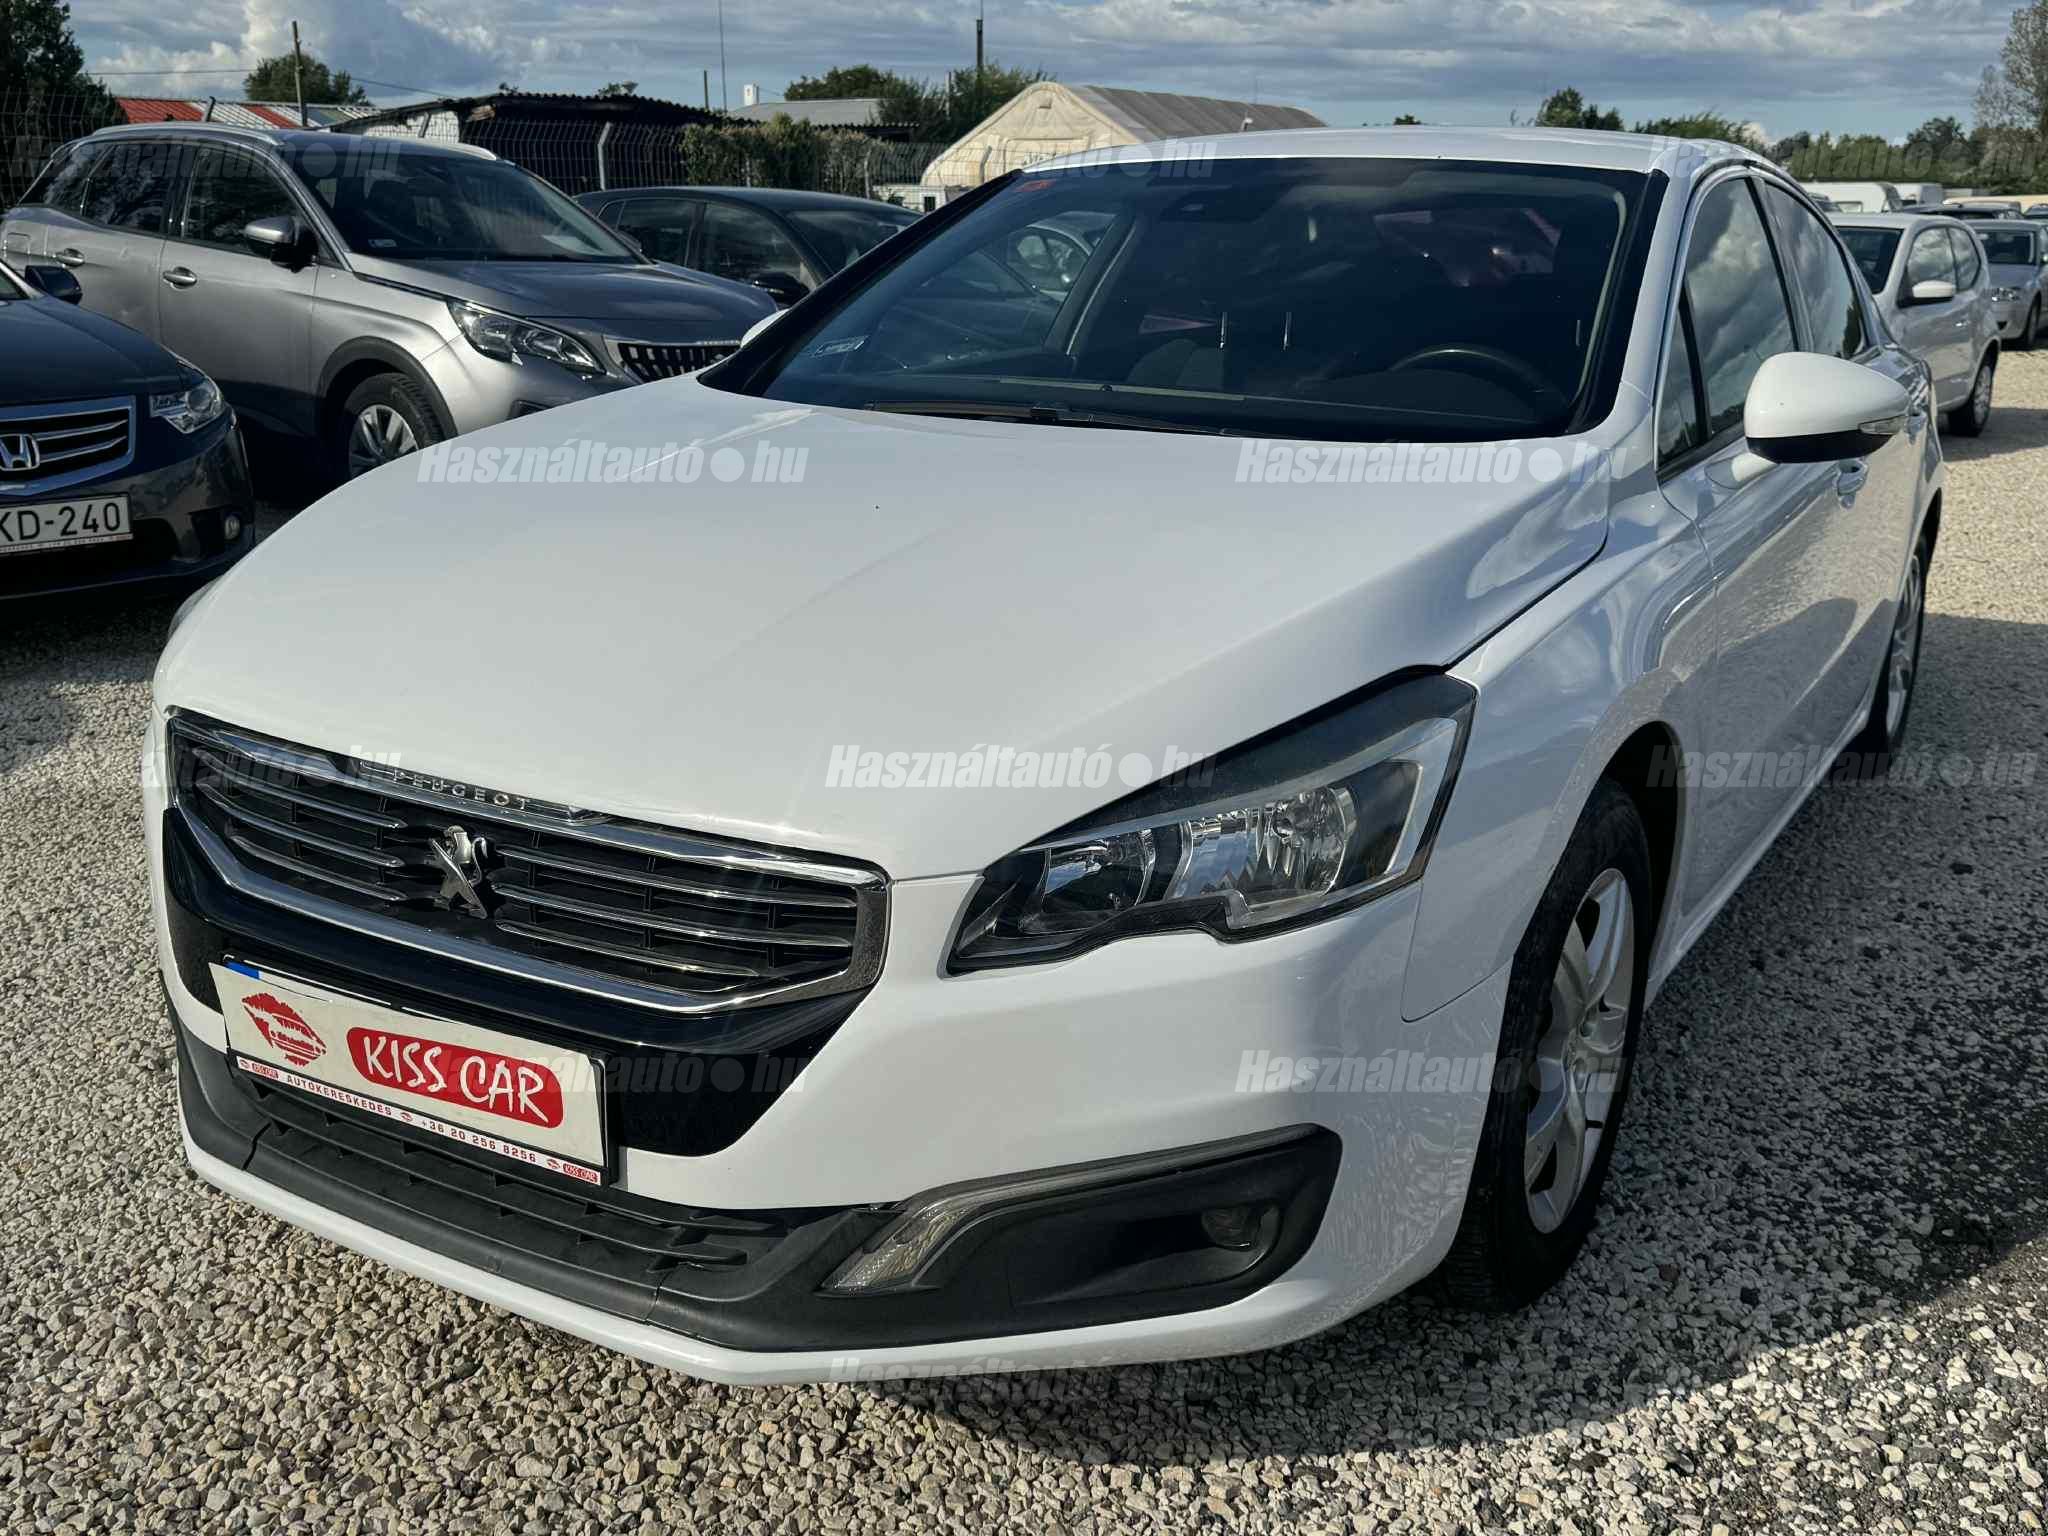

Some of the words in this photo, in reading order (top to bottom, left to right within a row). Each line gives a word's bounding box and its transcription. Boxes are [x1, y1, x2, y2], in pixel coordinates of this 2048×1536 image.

[393, 769, 530, 810] PEUGEOT
[363, 1035, 447, 1093] KISS
[460, 1056, 548, 1123] CAR
[451, 1128, 466, 1141] 20
[472, 1135, 496, 1150] 256
[503, 1144, 537, 1163] 8256
